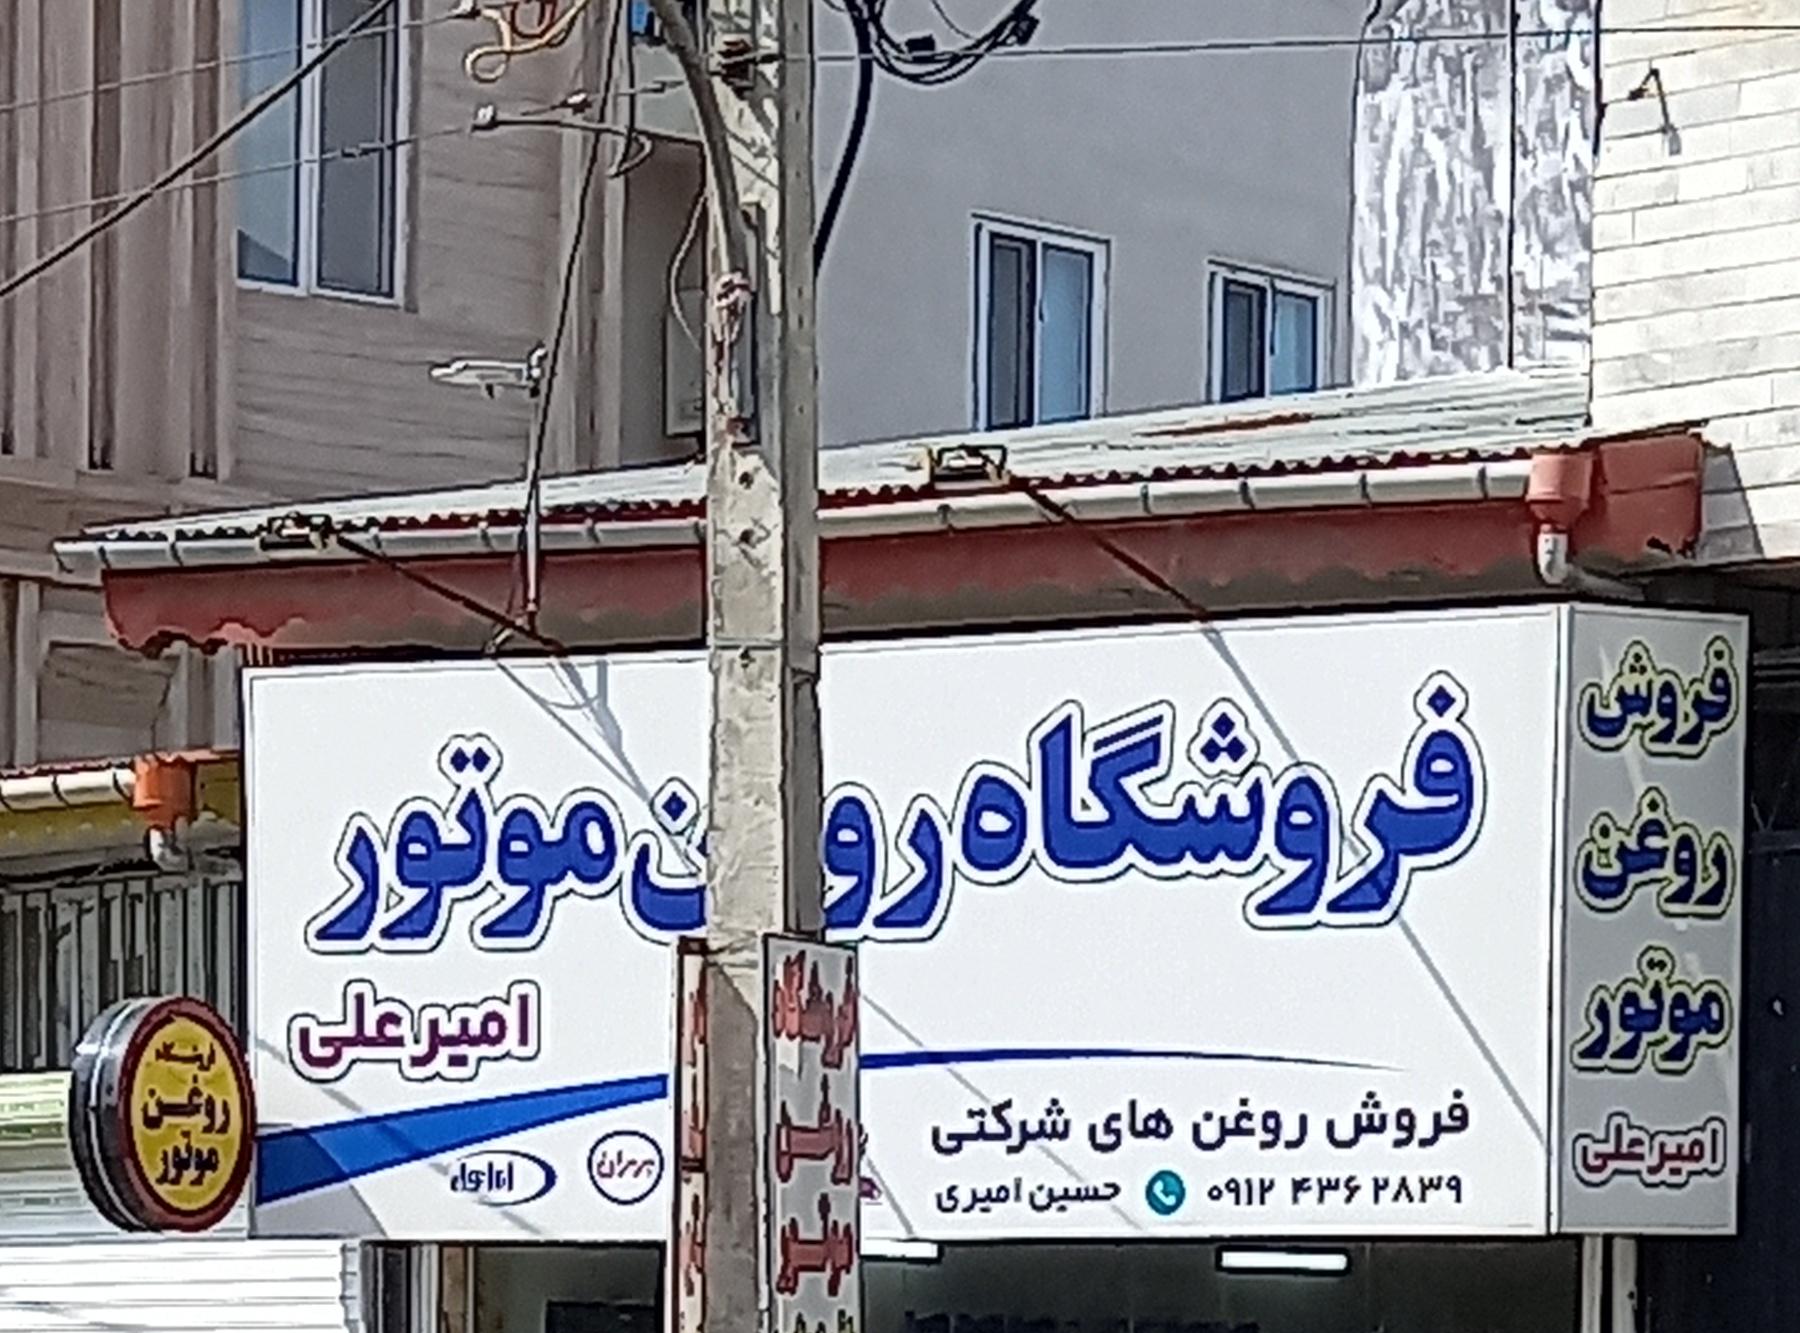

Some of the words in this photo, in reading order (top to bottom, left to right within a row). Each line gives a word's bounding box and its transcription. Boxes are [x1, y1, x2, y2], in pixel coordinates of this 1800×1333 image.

[1587, 649, 1731, 744] فروش
[960, 684, 1474, 917] فروشگاه
[313, 747, 618, 941] موتور
[631, 792, 943, 932] رون
[1583, 798, 1727, 905] روغن
[1579, 957, 1724, 1061] موتور
[141, 1074, 230, 1133] روغن
[777, 1074, 854, 1182] روغن
[931, 1098, 1070, 1155] شرکتی
[1088, 1099, 1174, 1153] های
[1192, 1098, 1308, 1151] روغن
[1326, 1089, 1469, 1149] فروش
[155, 1131, 219, 1185] موتور
[935, 1177, 1022, 1213] امیری
[1029, 1182, 1121, 1212] حسین
[1207, 1177, 1275, 1205] ۰۹۱۲
[1291, 1175, 1361, 1204] ۴۳۶
[1372, 1175, 1462, 1204] ۲۸۳۹
[776, 1193, 853, 1297] موتور
